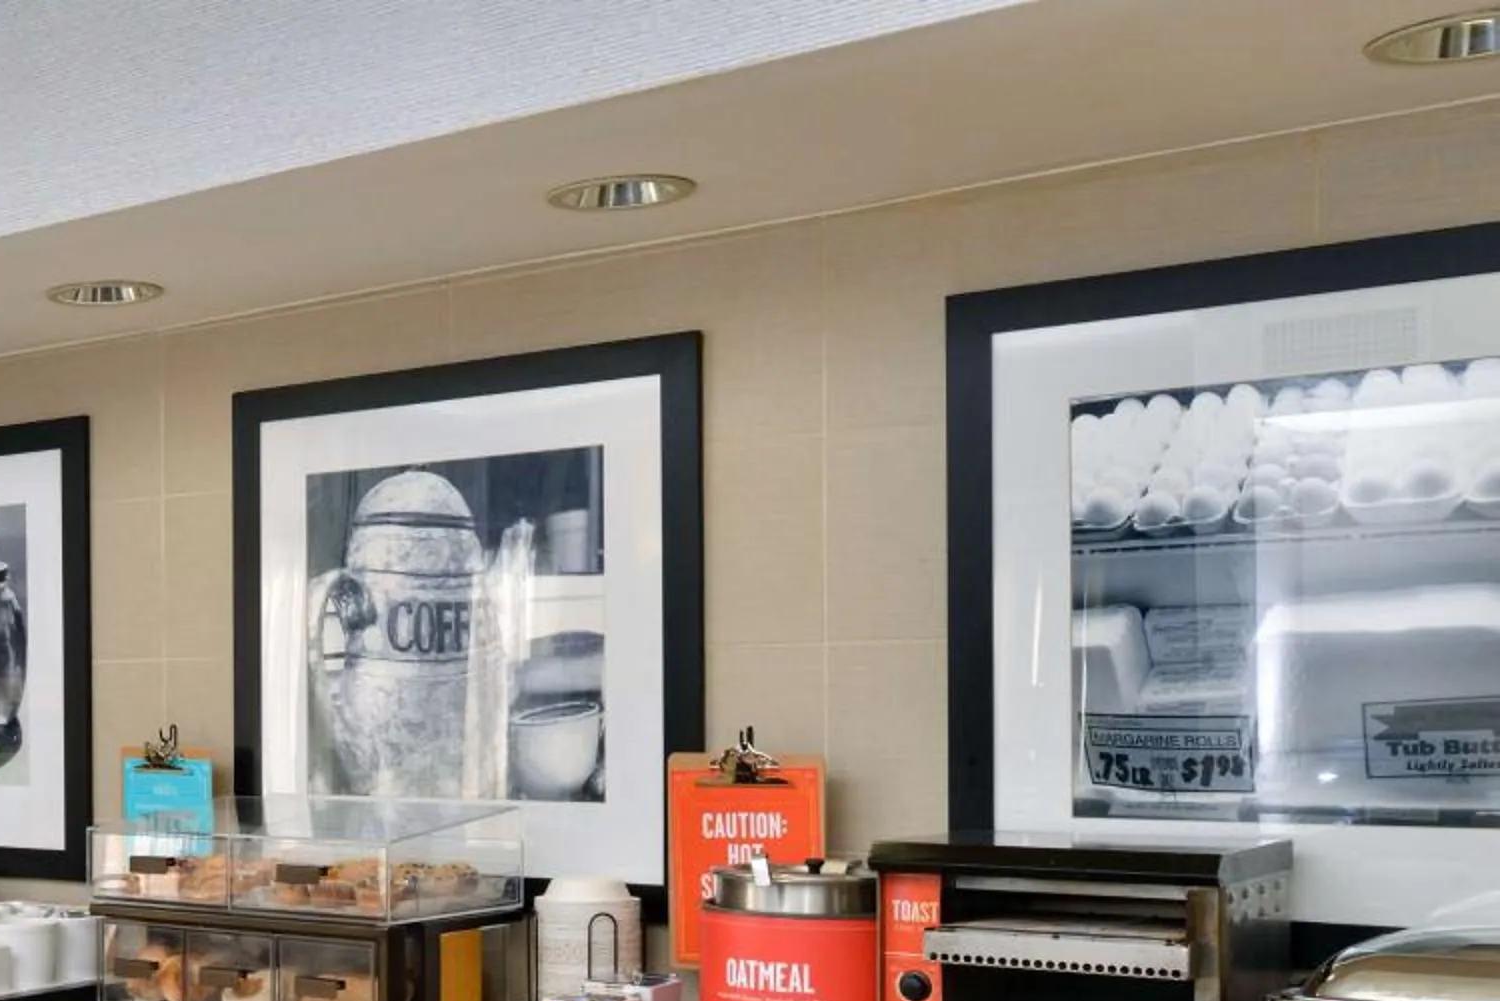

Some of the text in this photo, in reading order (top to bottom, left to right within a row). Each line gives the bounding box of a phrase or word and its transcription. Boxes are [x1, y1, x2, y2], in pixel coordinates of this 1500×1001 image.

[387, 600, 470, 654] COFF
[1184, 734, 1237, 748] ROLLS
[1385, 740, 1437, 757] Tub
[702, 811, 789, 840] CAUTION:
[891, 899, 939, 922] TOAST
[725, 957, 816, 994] OATMEAL
